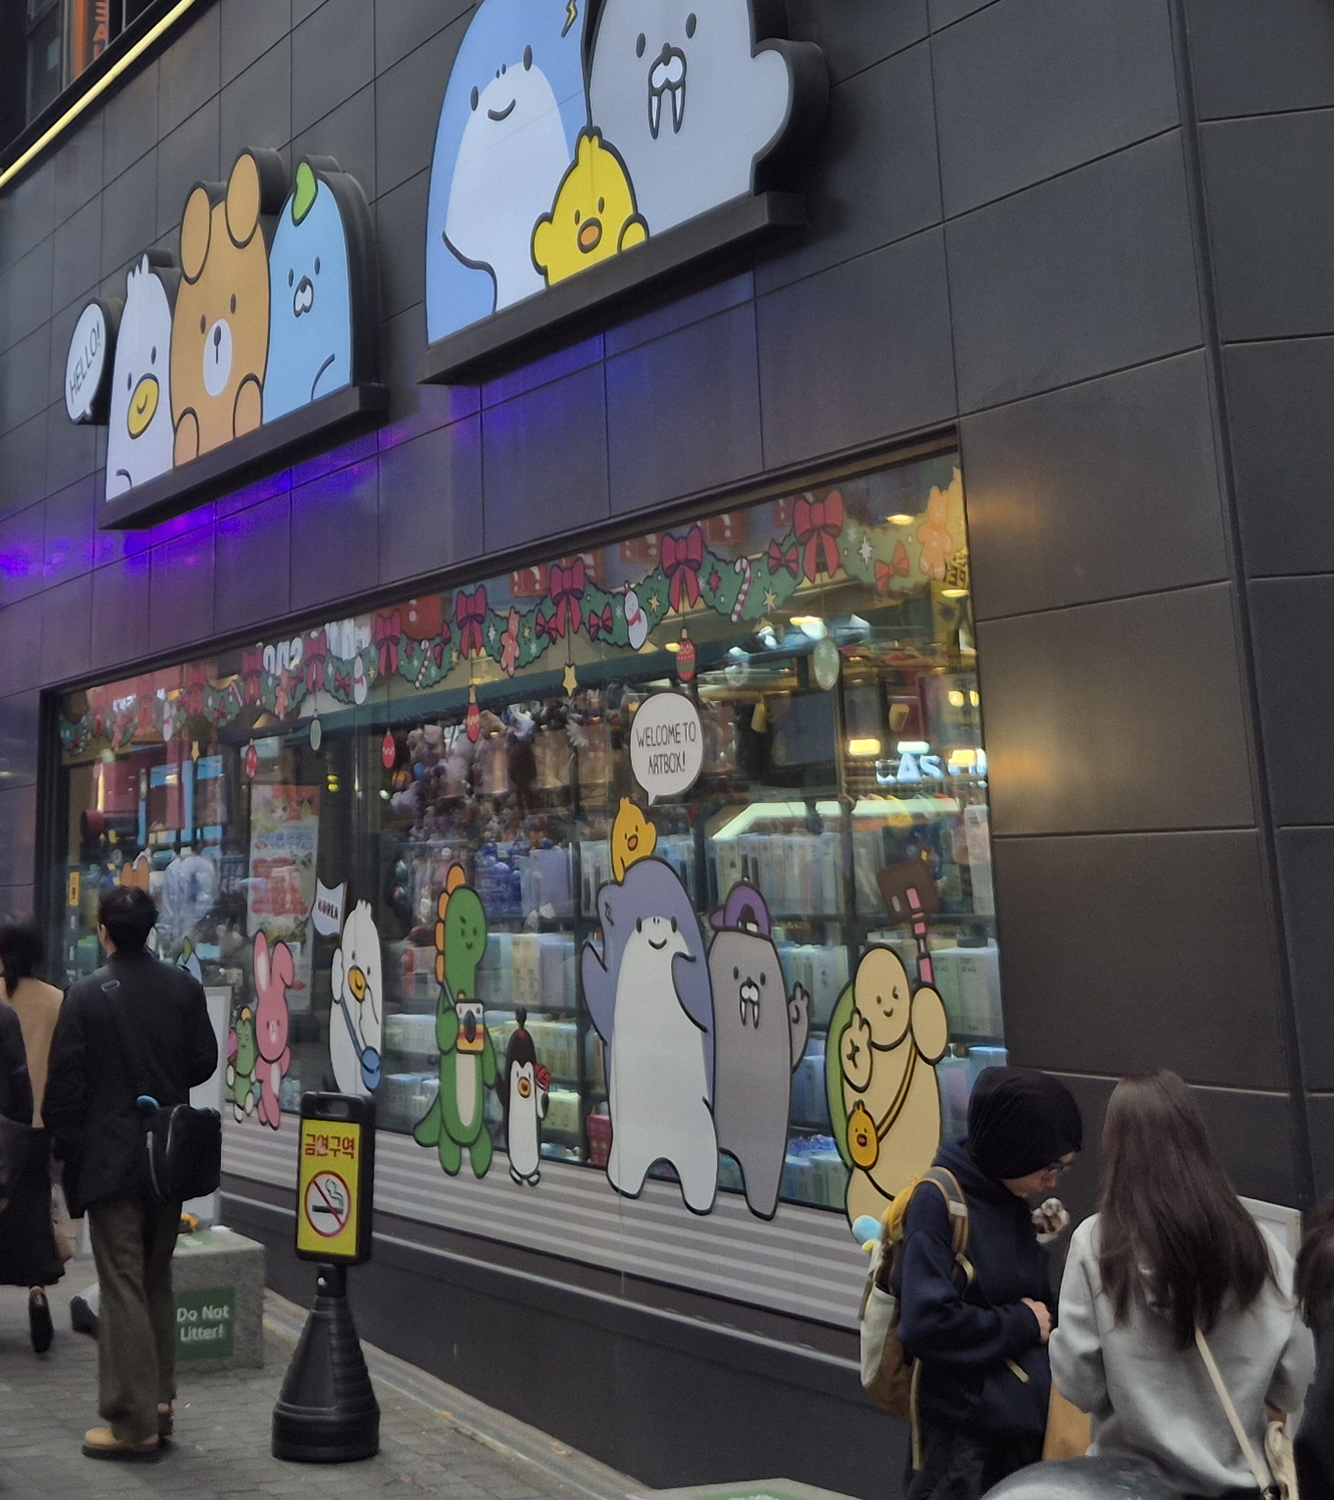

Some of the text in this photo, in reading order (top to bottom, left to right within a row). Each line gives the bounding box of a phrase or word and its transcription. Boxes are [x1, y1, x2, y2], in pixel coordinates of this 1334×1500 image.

[69, 320, 101, 403] HELLO!
[636, 721, 696, 747] WELCOME TO
[648, 751, 686, 775] ARTBOX!
[305, 1133, 355, 1159] 금연구역
[177, 1305, 230, 1322] Do Not
[180, 1323, 224, 1343] Litter!
